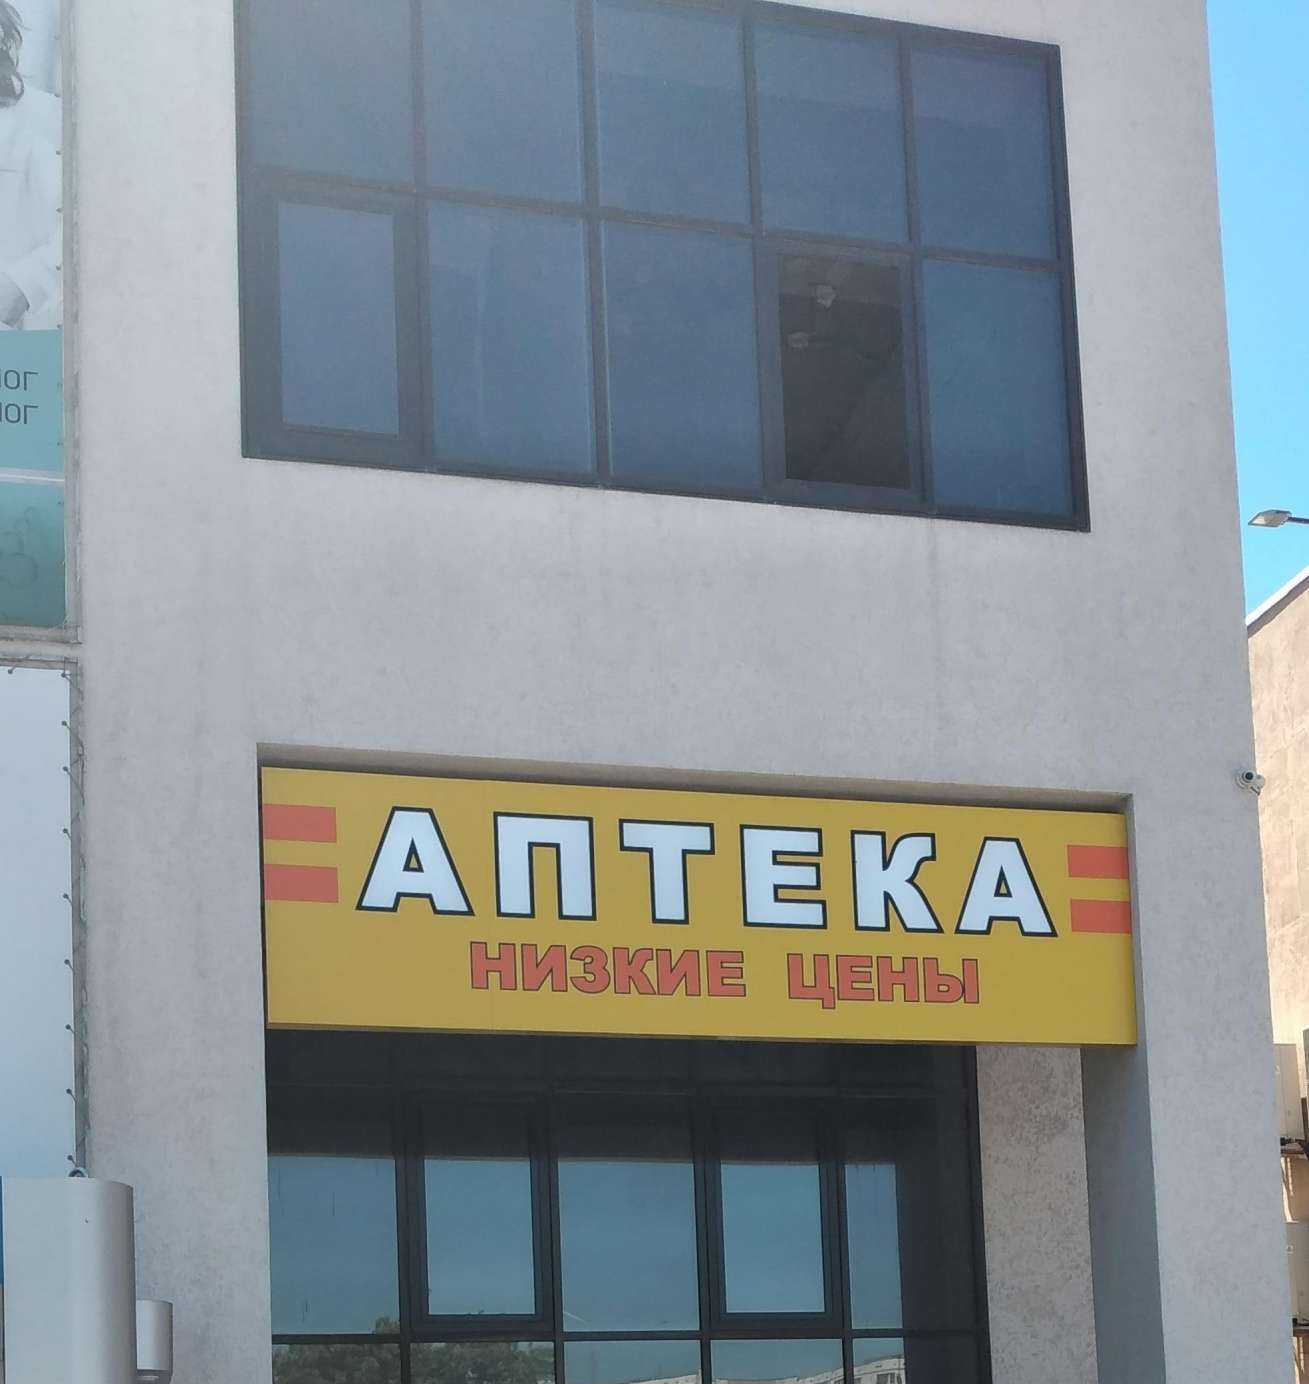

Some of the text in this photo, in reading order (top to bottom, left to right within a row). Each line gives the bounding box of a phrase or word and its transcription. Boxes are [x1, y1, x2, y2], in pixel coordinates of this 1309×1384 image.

[355, 805, 1060, 938] АПТЕКА
[469, 941, 981, 1010] НИЗКИЕ ЦЕНЫ
